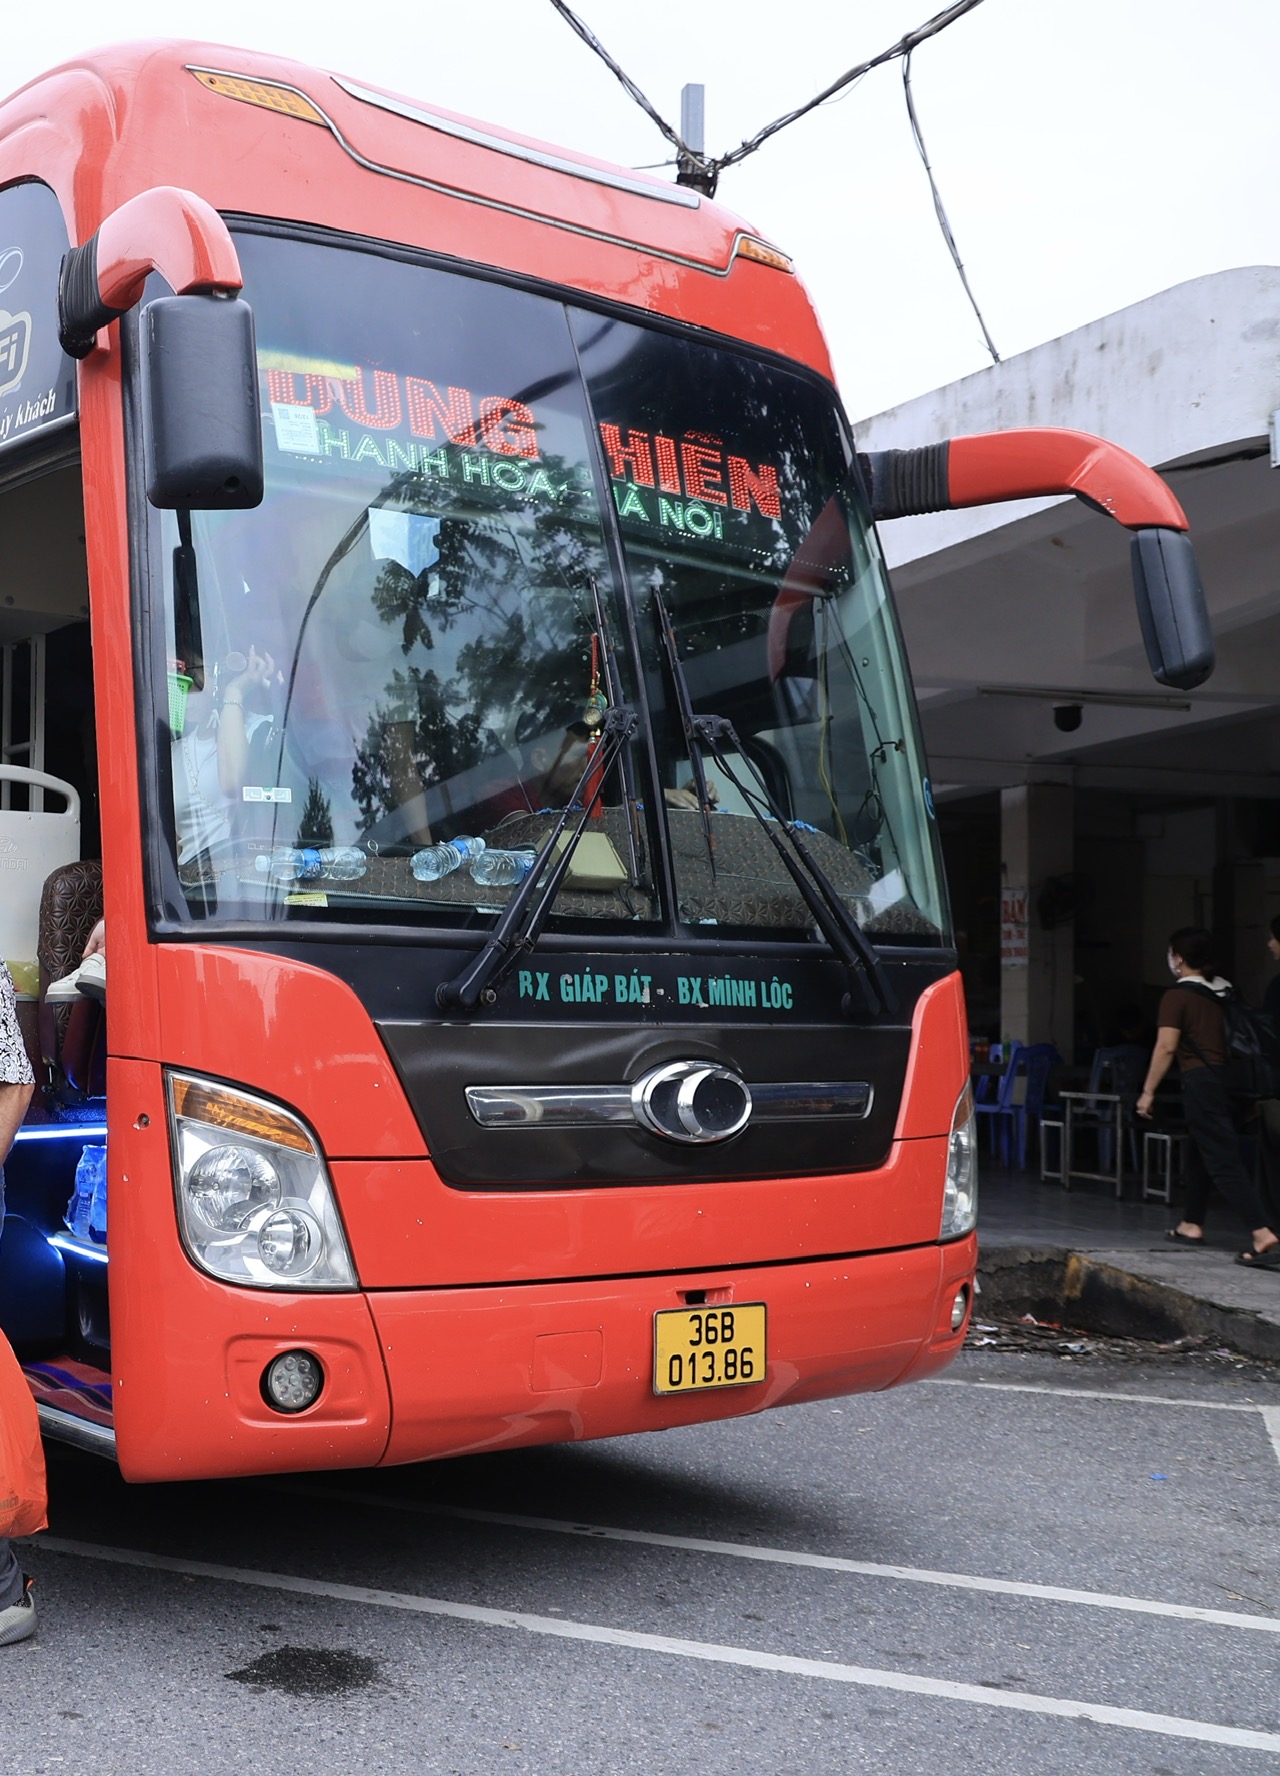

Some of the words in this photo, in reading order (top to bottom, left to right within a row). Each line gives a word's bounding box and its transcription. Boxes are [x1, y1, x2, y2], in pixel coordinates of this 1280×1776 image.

[320, 424, 450, 480] HANH
[560, 966, 609, 1003] GIÁP
[677, 976, 703, 1005] BX
[689, 1311, 734, 1346] 36B
[668, 1347, 753, 1387] 013.86
